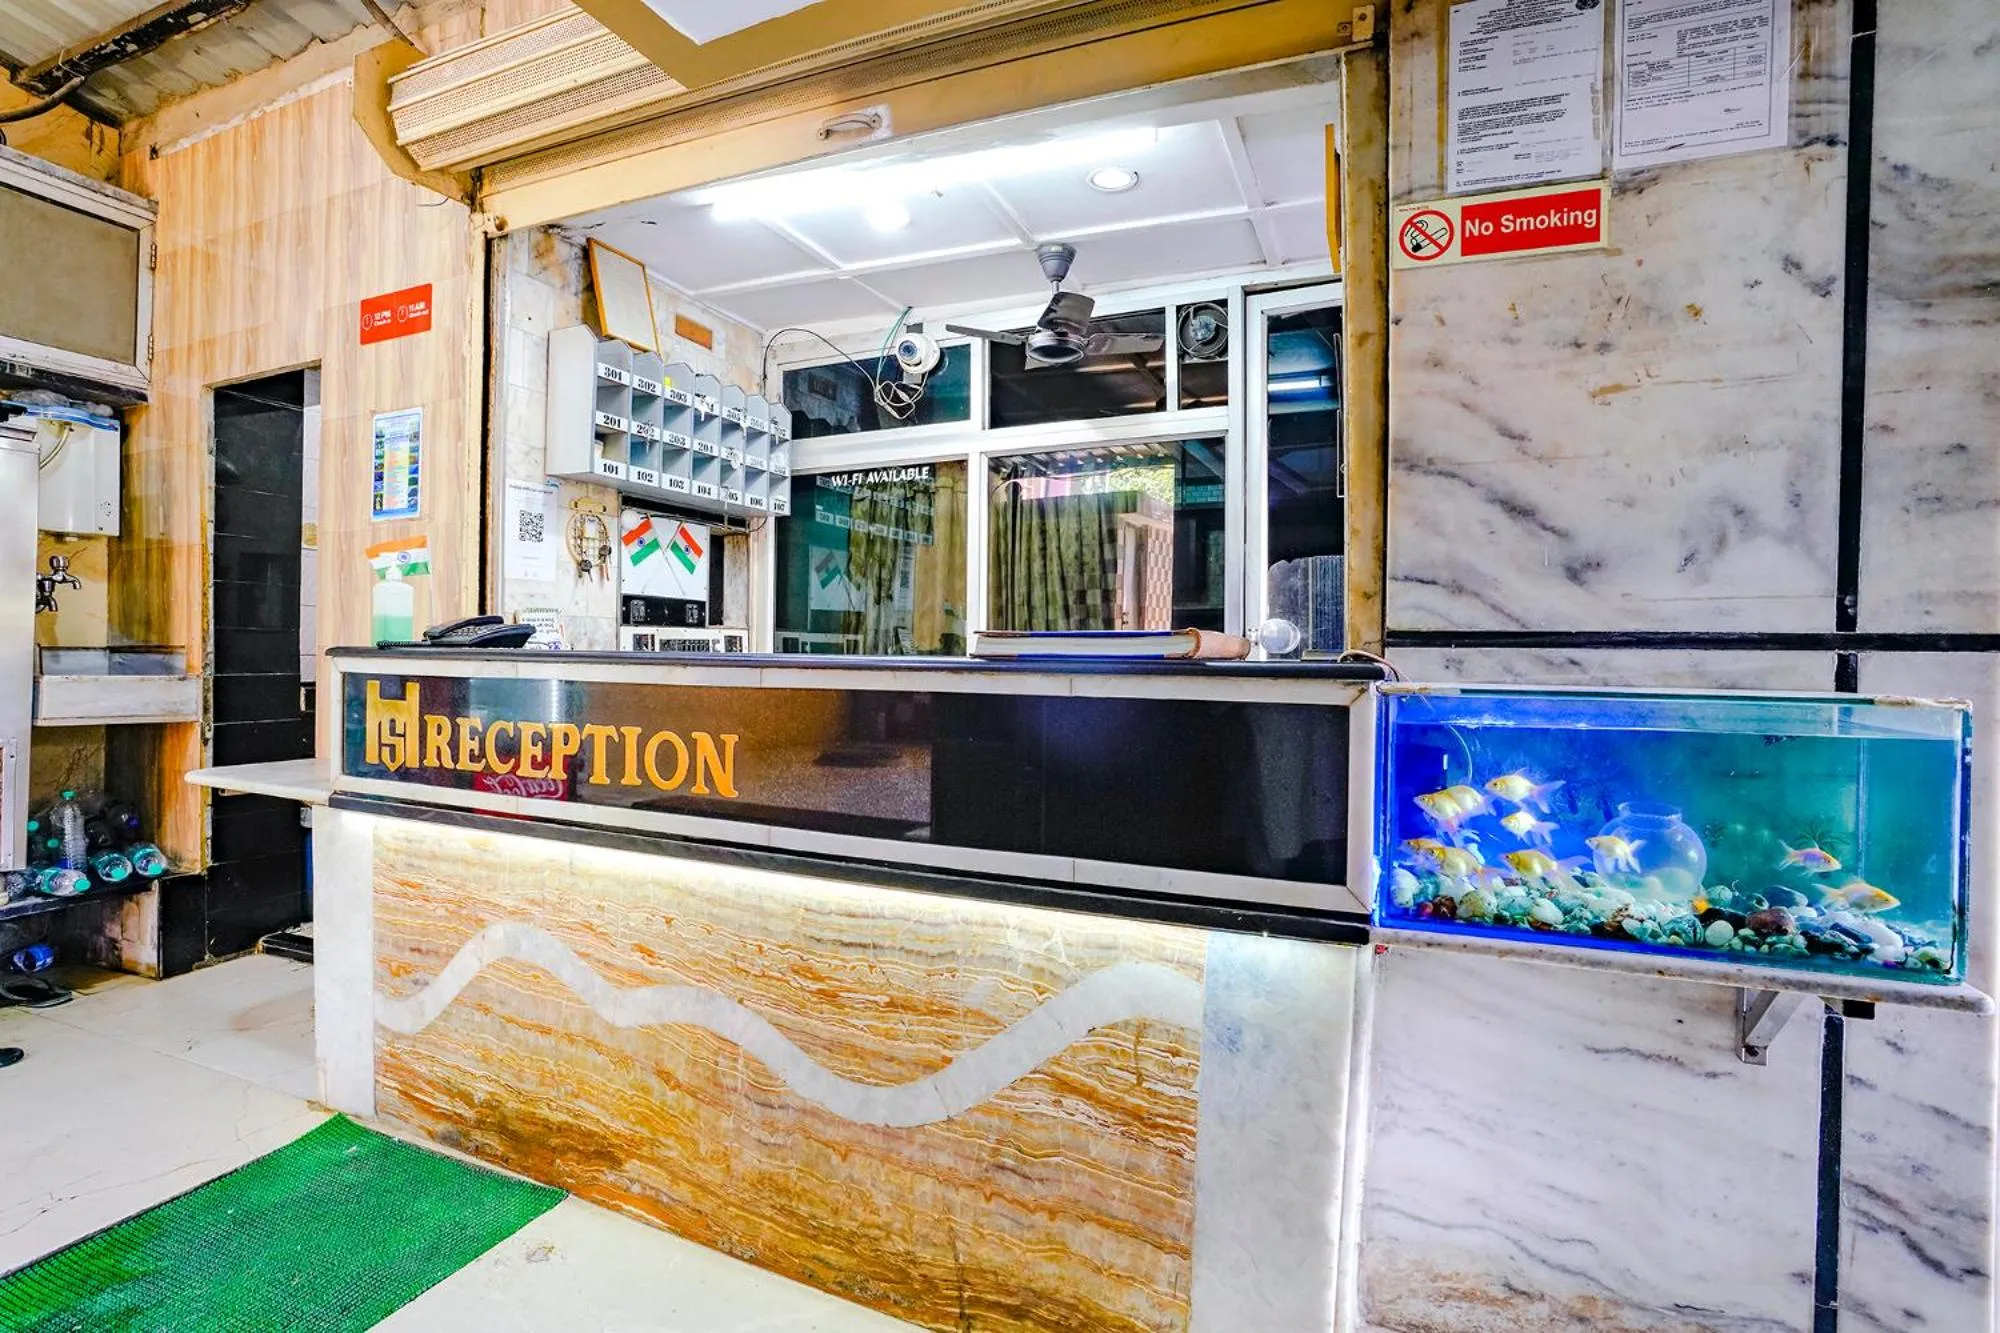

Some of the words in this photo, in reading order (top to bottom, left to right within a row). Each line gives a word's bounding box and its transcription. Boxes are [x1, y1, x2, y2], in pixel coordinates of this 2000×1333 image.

[1464, 218, 1494, 238] No
[1500, 208, 1597, 235] Smoking
[604, 366, 622, 381] 301
[638, 378, 656, 393] 302
[670, 389, 688, 403] 303
[603, 414, 621, 429] 201
[636, 423, 655, 438] 202
[668, 433, 686, 446] 203
[698, 441, 713, 453] 204
[602, 463, 619, 475] 101
[866, 466, 930, 484] AVAILABLE
[637, 470, 653, 483] 102
[669, 478, 685, 490] 103
[697, 485, 711, 496] 104
[750, 497, 763, 506] 106
[774, 502, 785, 511] 107
[423, 713, 740, 799] RECEPTION
